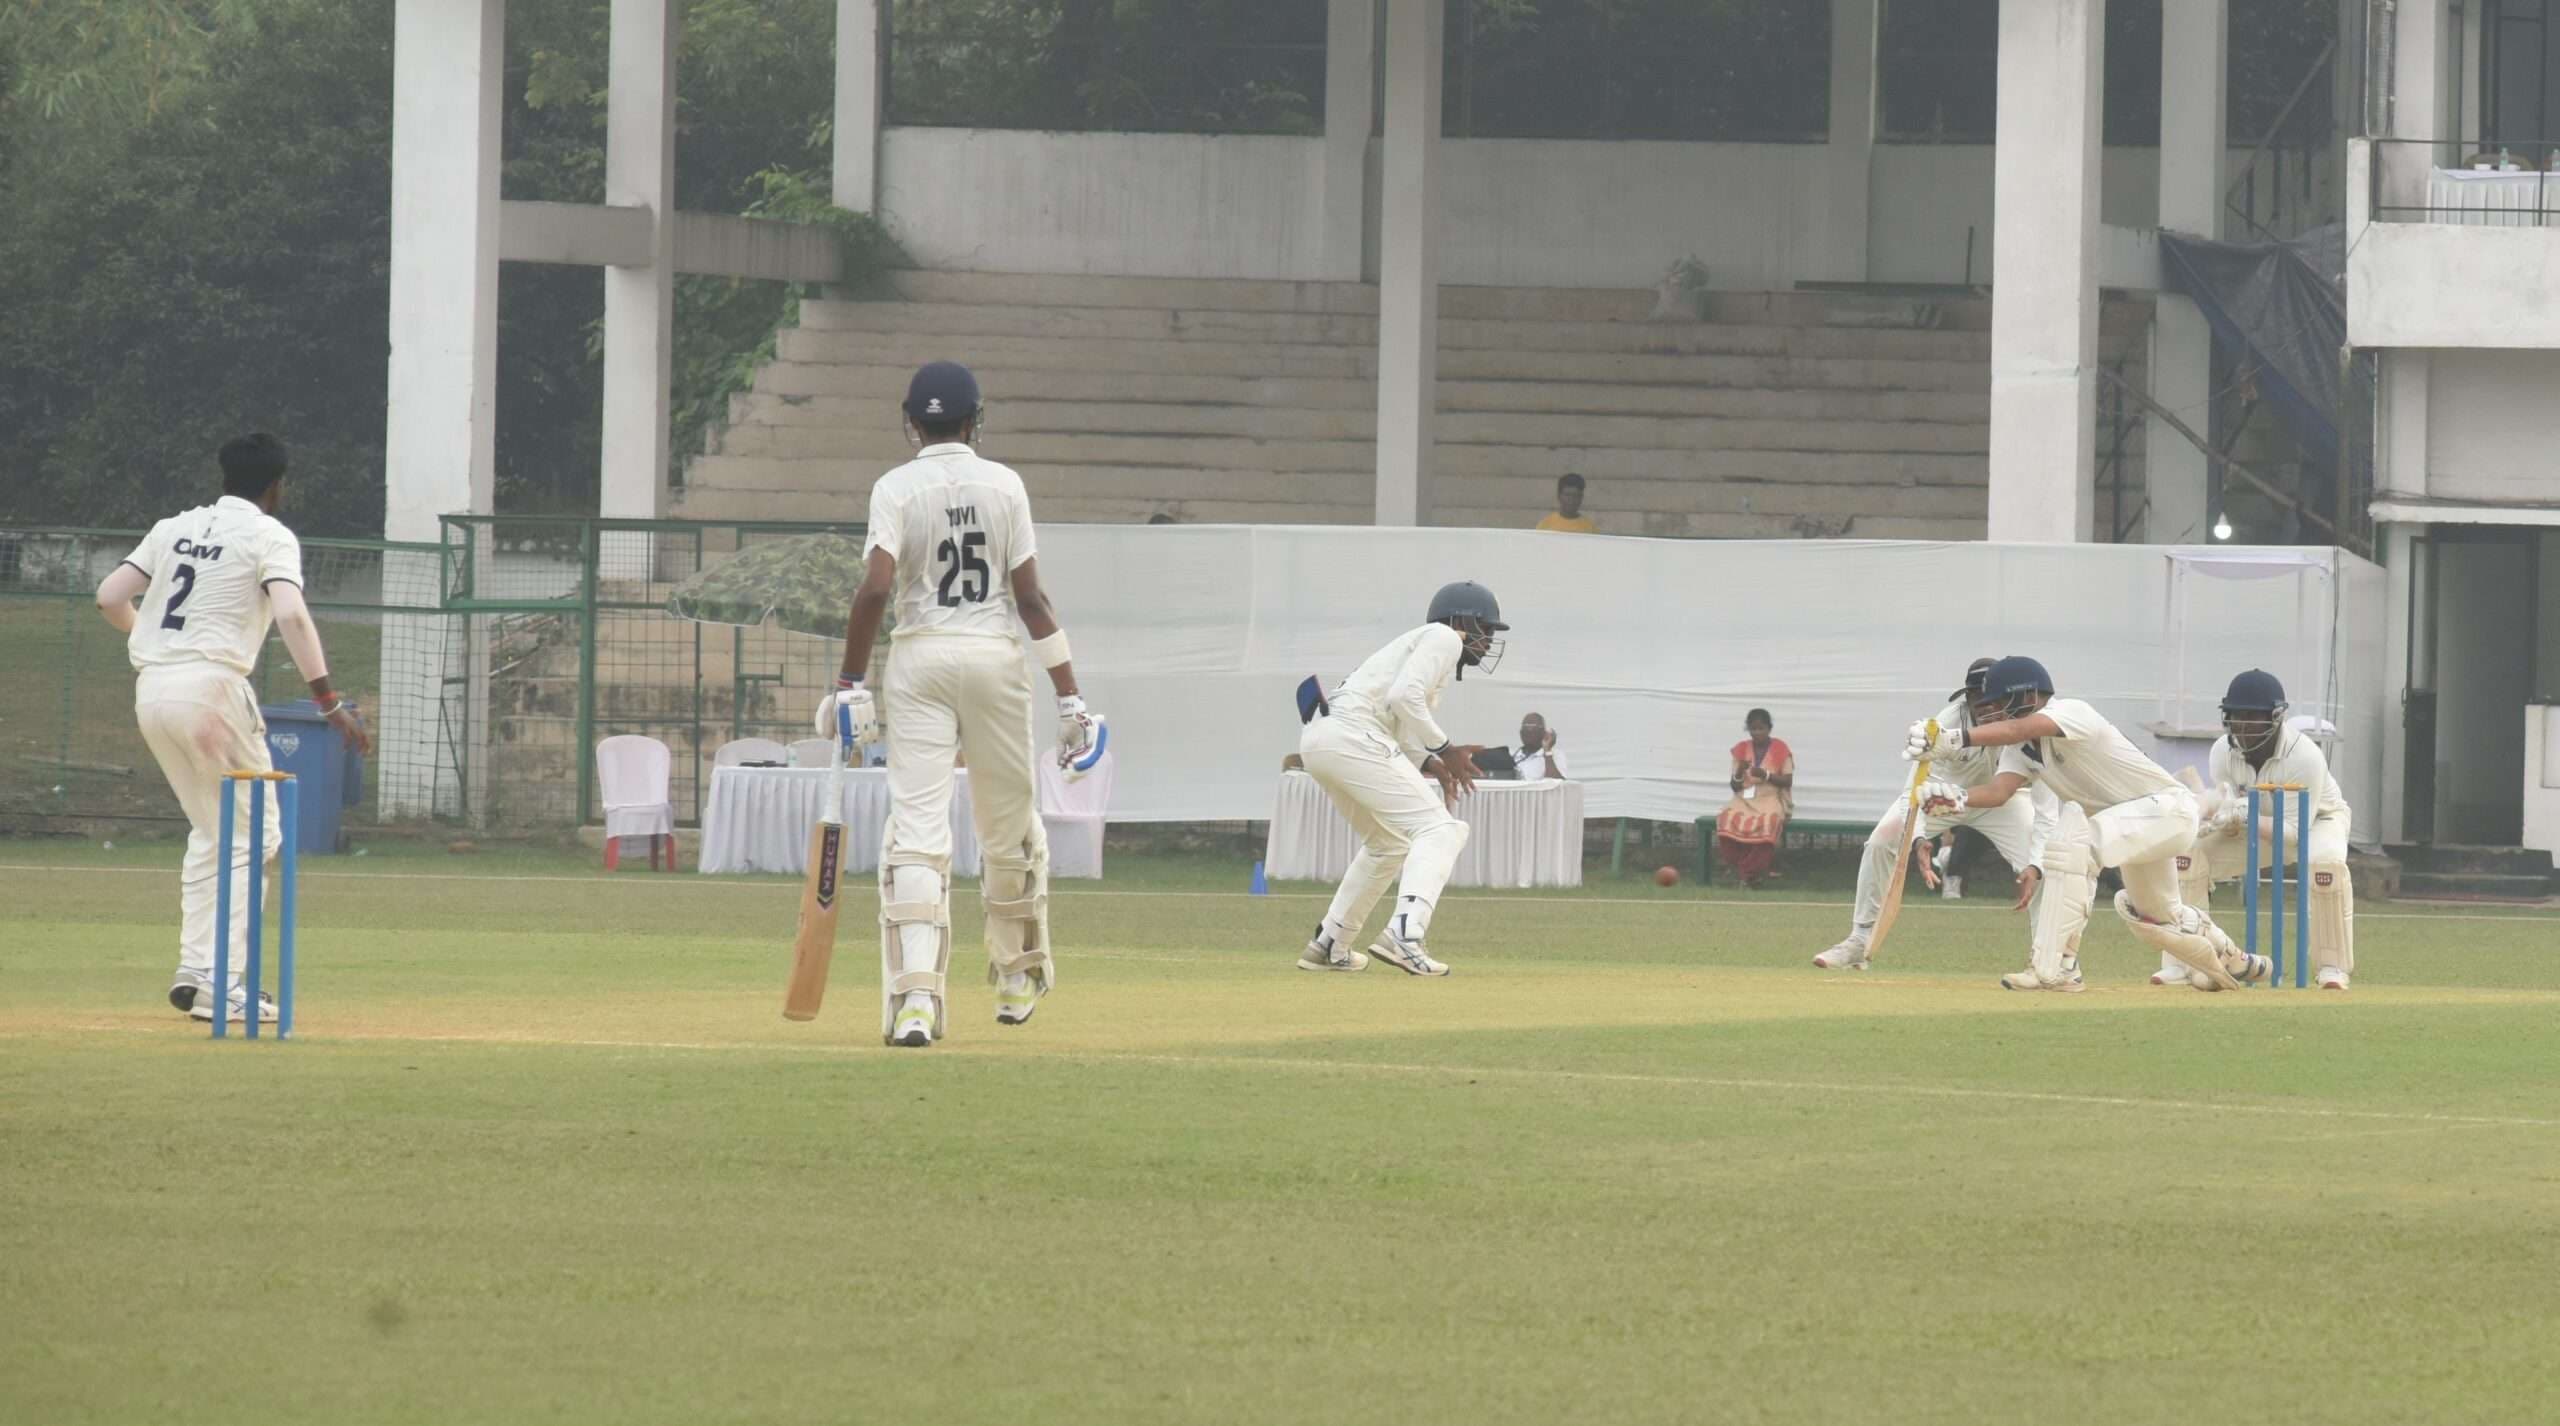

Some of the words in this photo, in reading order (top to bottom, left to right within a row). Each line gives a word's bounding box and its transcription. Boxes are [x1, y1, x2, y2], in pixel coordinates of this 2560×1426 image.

[945, 505, 976, 527] YUVI
[161, 563, 195, 631] 2
[937, 531, 989, 607] 25
